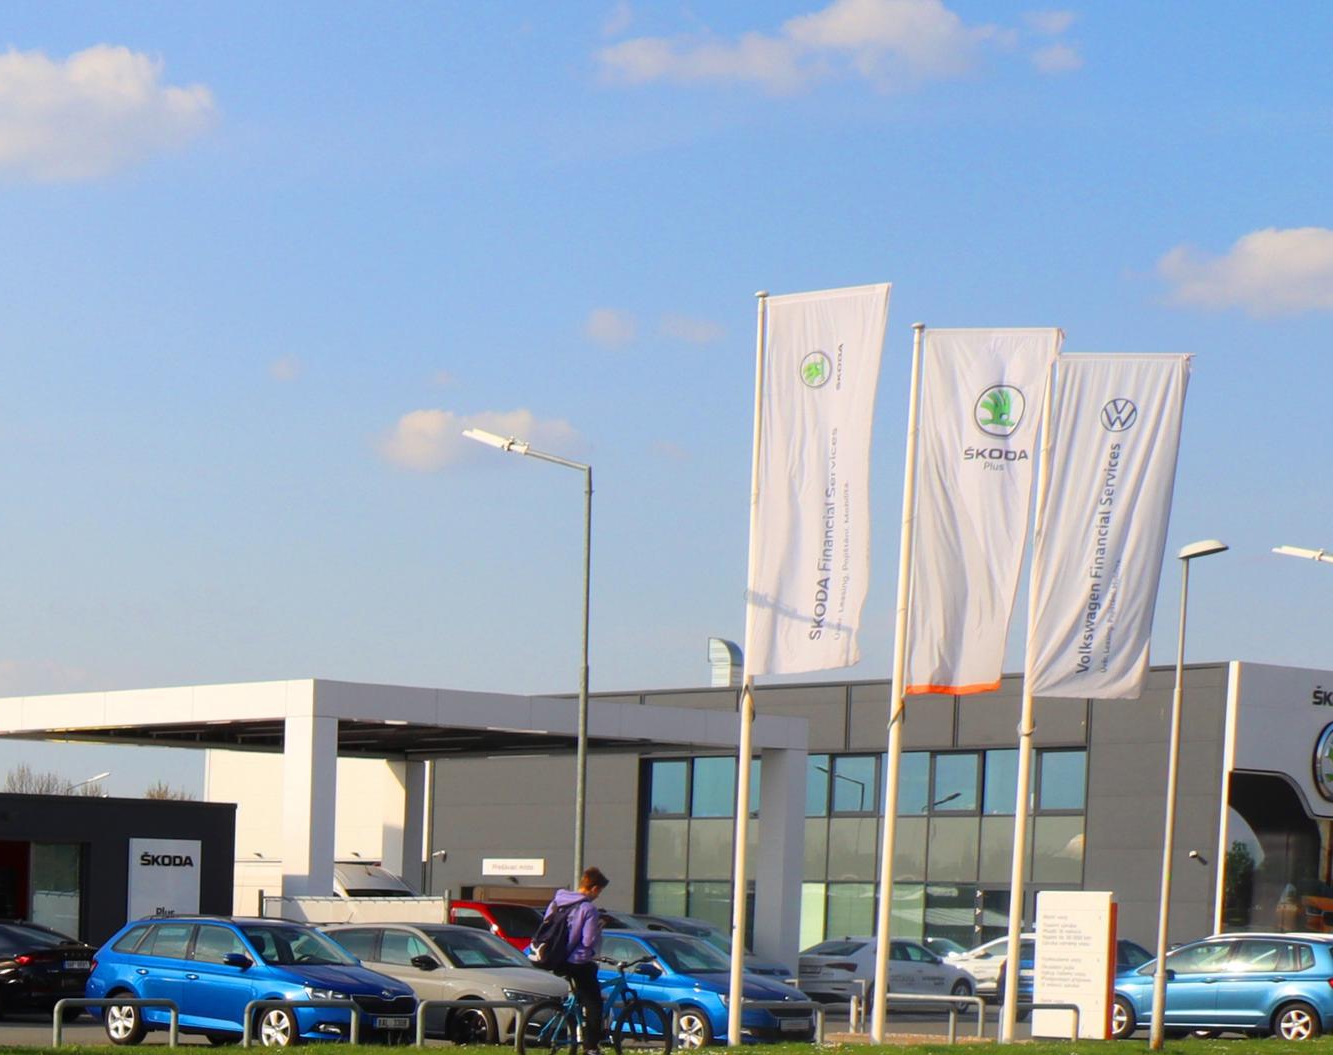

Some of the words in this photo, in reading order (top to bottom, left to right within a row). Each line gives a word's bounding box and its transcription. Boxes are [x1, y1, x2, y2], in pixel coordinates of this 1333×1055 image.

[825, 426, 838, 497] Services
[963, 447, 1029, 462] ŠKODA
[983, 462, 1005, 471] Plus
[1100, 443, 1121, 506] Services
[817, 497, 837, 573] Financial
[1090, 510, 1111, 579] Financial
[1076, 582, 1102, 675] Volkswagen
[140, 852, 194, 867] ŠKODA
